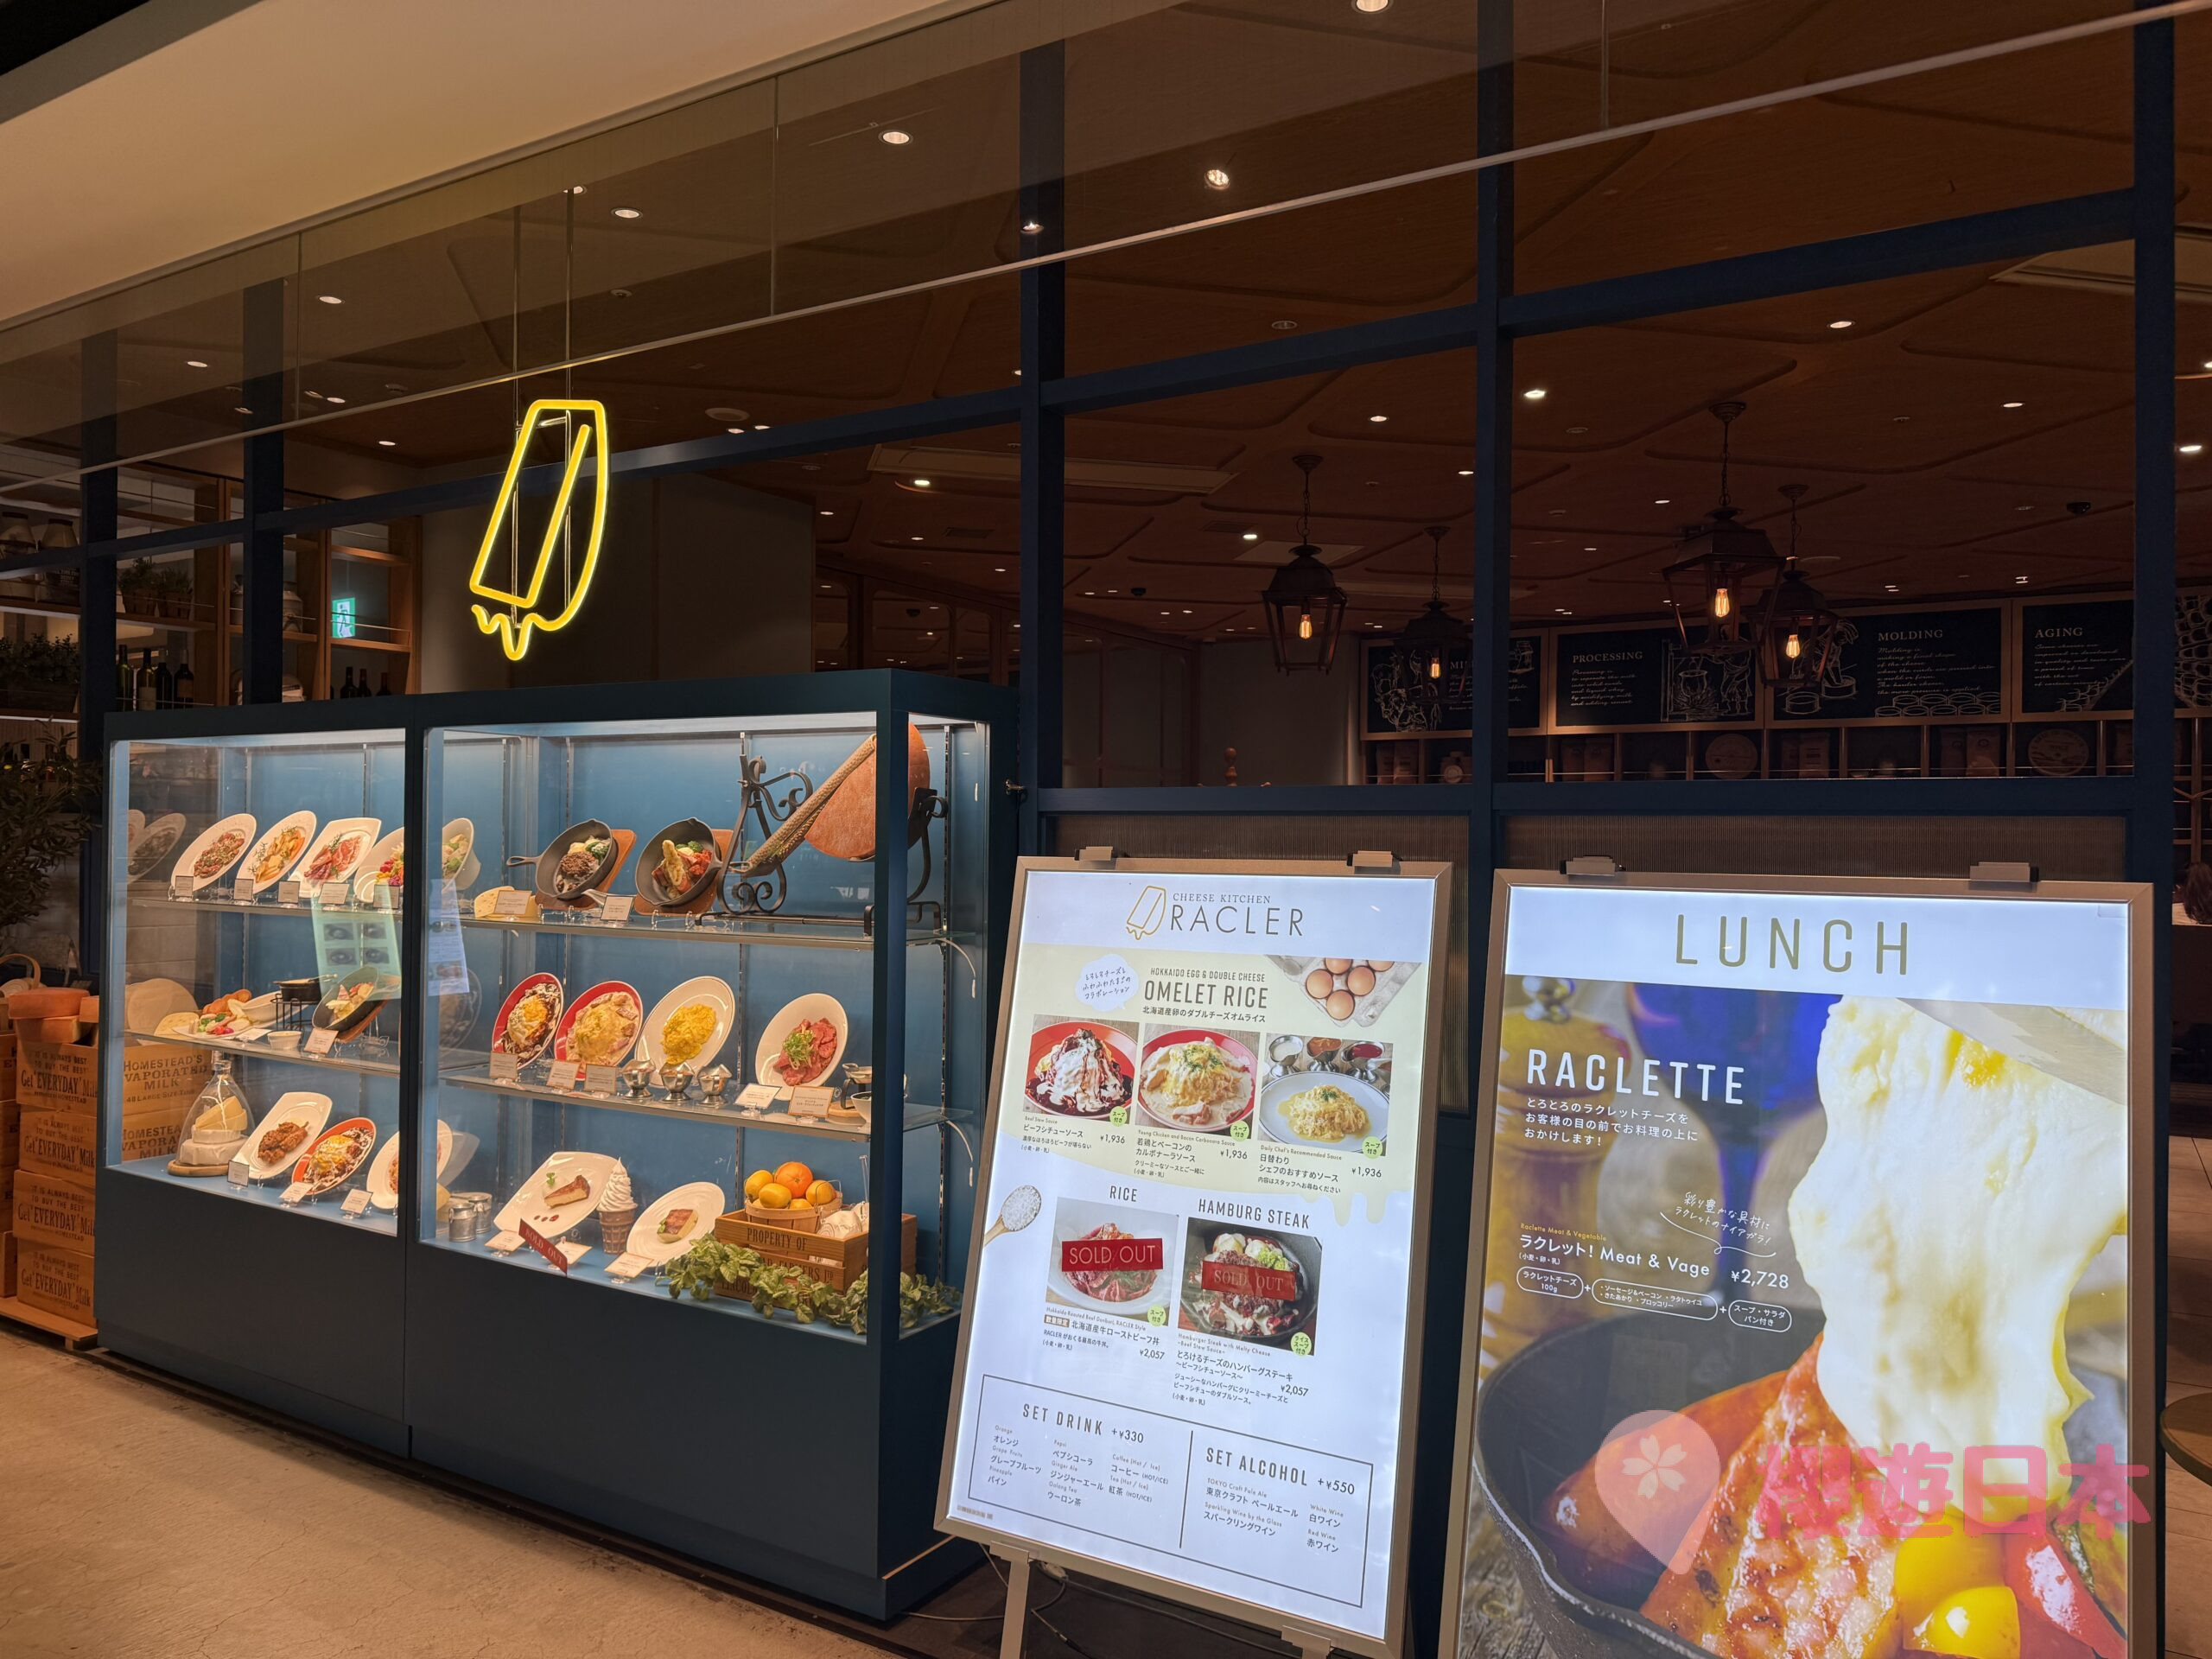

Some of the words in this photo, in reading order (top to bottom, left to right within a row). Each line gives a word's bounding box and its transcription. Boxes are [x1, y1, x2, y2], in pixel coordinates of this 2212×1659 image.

[1878, 629, 1942, 641] MOLDING
[2035, 627, 2082, 639] AGING
[1573, 652, 1643, 664] PROCESSING
[1173, 893, 1215, 902] CHEESE
[1220, 894, 1270, 904] KITCHEN
[1171, 905, 1303, 936] RACLER
[1675, 913, 1909, 976] LUNCH
[1151, 968, 1185, 976] HOKKAIDO
[1210, 971, 1236, 980] DOUBLE
[1239, 973, 1265, 982] CHEESE
[1085, 987, 1129, 999] コラボレーション
[1145, 981, 1216, 1004] OMELET
[1224, 985, 1268, 1008] RICE
[1143, 1006, 1265, 1022] 北海道産卵のダブルチーズオムライス
[124, 1055, 202, 1071] HOMESTEAD'S
[124, 1065, 208, 1082] VAPORATED
[1528, 1049, 1745, 1104] RACLETTE
[144, 1078, 179, 1090] MILK
[1527, 1097, 1688, 1124] とろとろのラクレットチーズを
[123, 1125, 182, 1140] HOMESTEA
[1024, 1124, 1083, 1137] ビーフシチューソース
[1525, 1113, 1698, 1141] お客様の目の前でお料理の上に
[1101, 1135, 1125, 1143] ¥1,936
[1137, 1138, 1192, 1151] 若鶏とベーコンの
[1524, 1128, 1601, 1146] おかけします!
[1136, 1148, 1195, 1162] カルボナーラソース
[1220, 1149, 1247, 1159] ¥1,936
[1260, 1154, 1289, 1164] 日替わり
[1291, 1149, 1325, 1158] Recommended
[1135, 1160, 1205, 1174] クリーミーなソースとご一緒に
[1259, 1165, 1338, 1182] シェフのおすすめソース
[1352, 1166, 1382, 1178] ¥1,936
[1258, 1177, 1340, 1193] 内容はスタッフへお尋ねください
[1110, 1185, 1138, 1202] RICE
[1198, 1198, 1262, 1221] HAMBURG
[1268, 1210, 1310, 1229] STEAK
[1684, 1192, 1770, 1230] 彩り豊かな具材に
[747, 1228, 792, 1248] PROPERTY
[797, 1237, 808, 1250] OF
[1521, 1223, 1546, 1232] Raclette
[1573, 1231, 1606, 1242] Vegetable
[526, 1229, 543, 1249] SOLD
[548, 1247, 563, 1264] OUT
[1069, 1247, 1111, 1264] SOLD
[1120, 1246, 1155, 1262] OUT
[1520, 1235, 1593, 1258] ラクレット!
[1600, 1247, 1641, 1265] Meat
[1649, 1254, 1659, 1268] &
[1668, 1256, 1709, 1278] Vage
[1732, 1269, 1789, 1288] ¥2,728
[1214, 1270, 1247, 1287] SOLD
[1256, 1276, 1283, 1292] OUT
[1523, 1271, 1577, 1286] ラクレットチーズ
[1541, 1283, 1557, 1293] 100g
[1734, 1305, 1785, 1319] スープ・サラダ
[1745, 1316, 1774, 1326] パン付き
[1071, 1321, 1160, 1345] 北海道産牛ローストビーフ丼
[1140, 1349, 1165, 1359] ¥2,057
[1177, 1351, 1293, 1382] とろけるチーズのハンバーグステーキ
[1173, 1382, 1251, 1405] ビーフシチューのダブルソース。
[1174, 1373, 1288, 1403] ジューシーなハンバーグにクリーミーチーズと
[1281, 1384, 1309, 1396] ¥2,057
[1023, 1403, 1048, 1422] SET
[1057, 1411, 1103, 1435] DRINK
[993, 1435, 1019, 1446] オレンジ
[990, 1455, 1041, 1474] グレープフルーツ
[1052, 1450, 1093, 1466] ペプシコーラ
[1111, 1465, 1139, 1477] コーヒー
[1206, 1447, 1232, 1467] SET
[1239, 1456, 1307, 1486] ALCOHOL
[988, 1476, 1007, 1486] パイン
[1050, 1471, 1103, 1491] ジンジャーエール
[1207, 1478, 1227, 1487] TOKYO
[1229, 1482, 1243, 1491] Craft
[1109, 1485, 1123, 1496] 紅茶
[1047, 1491, 1082, 1507] ウーロン茶
[1206, 1487, 1249, 1504] 東京クラフト
[1252, 1500, 1299, 1518] ペールエール
[1205, 1502, 1230, 1515] Sparkling
[1232, 1508, 1245, 1517] Wine
[1266, 1518, 1282, 1528] Glass
[1310, 1503, 1328, 1515] White
[1330, 1509, 1344, 1518] Wine
[1204, 1511, 1275, 1536] スパークリングワイン
[1309, 1514, 1340, 1528] 白ワイン
[1321, 1532, 1336, 1541] Wine
[1306, 1538, 1338, 1553] 赤ワイン
